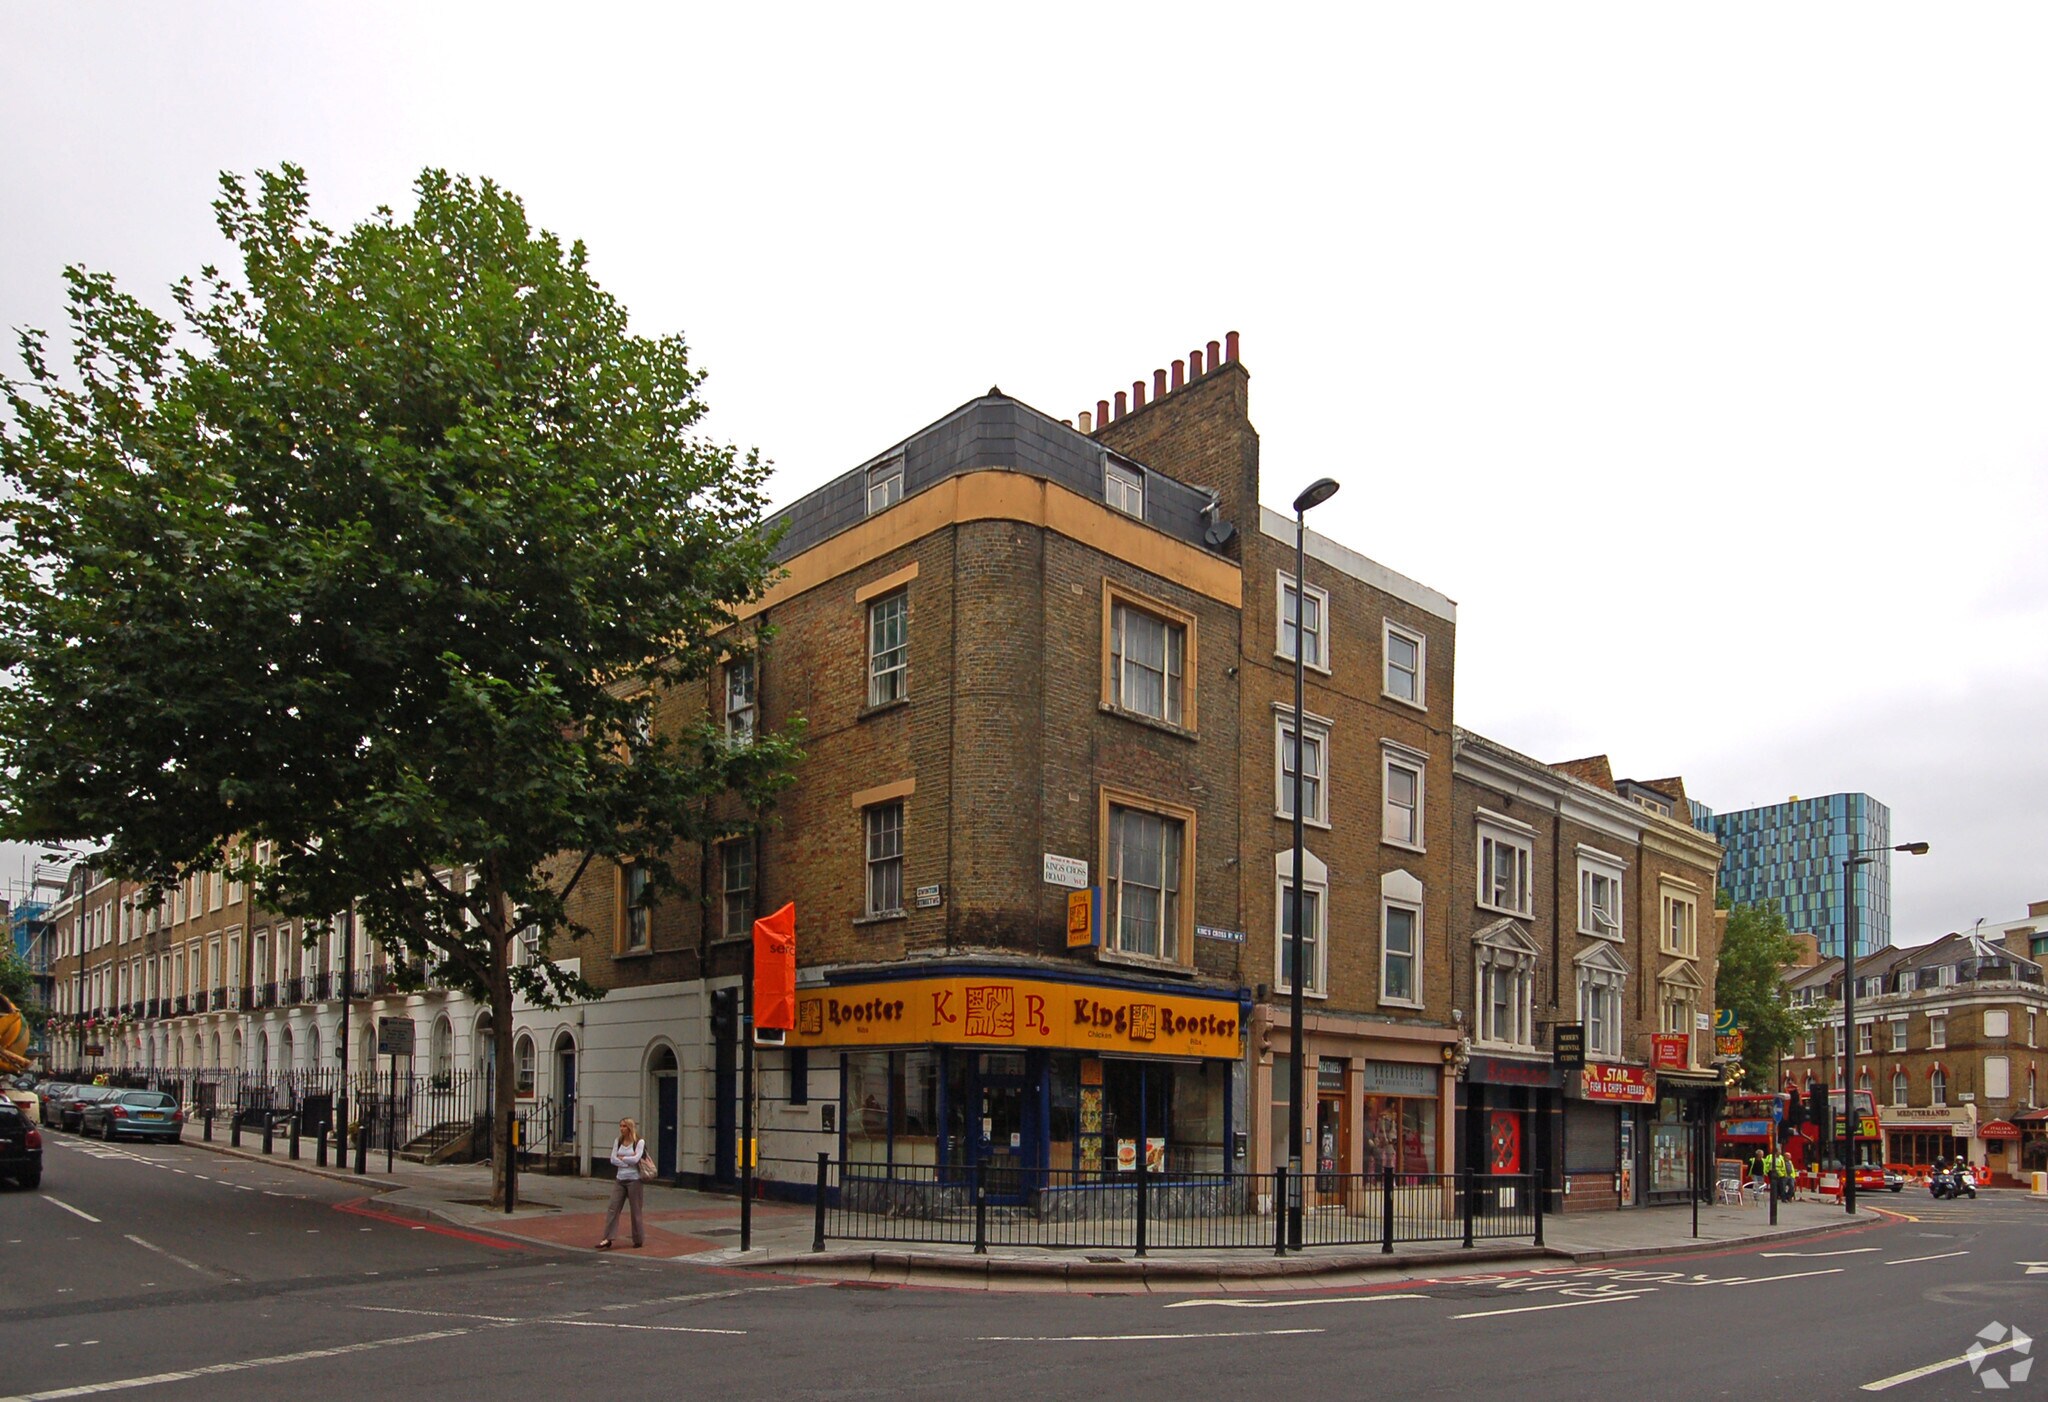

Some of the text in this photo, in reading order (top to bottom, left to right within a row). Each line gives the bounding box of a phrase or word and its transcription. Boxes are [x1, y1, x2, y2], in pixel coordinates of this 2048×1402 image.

[1045, 861, 1087, 877] KINGS CROSS
[1045, 871, 1066, 882] ROAD
[828, 997, 904, 1026] Rooster
[931, 989, 1050, 1036] K R
[1073, 998, 1236, 1037] King Rooster
[1087, 1030, 1113, 1040] Chicken
[1603, 1068, 1633, 1083] STAR
[1590, 1081, 1602, 1092] FISH
[1603, 1082, 1607, 1093] &
[1608, 1083, 1623, 1094] CHIPS
[1627, 1085, 1645, 1096] KEBABS
[1897, 1109, 1951, 1117] MEDITERRANEO
